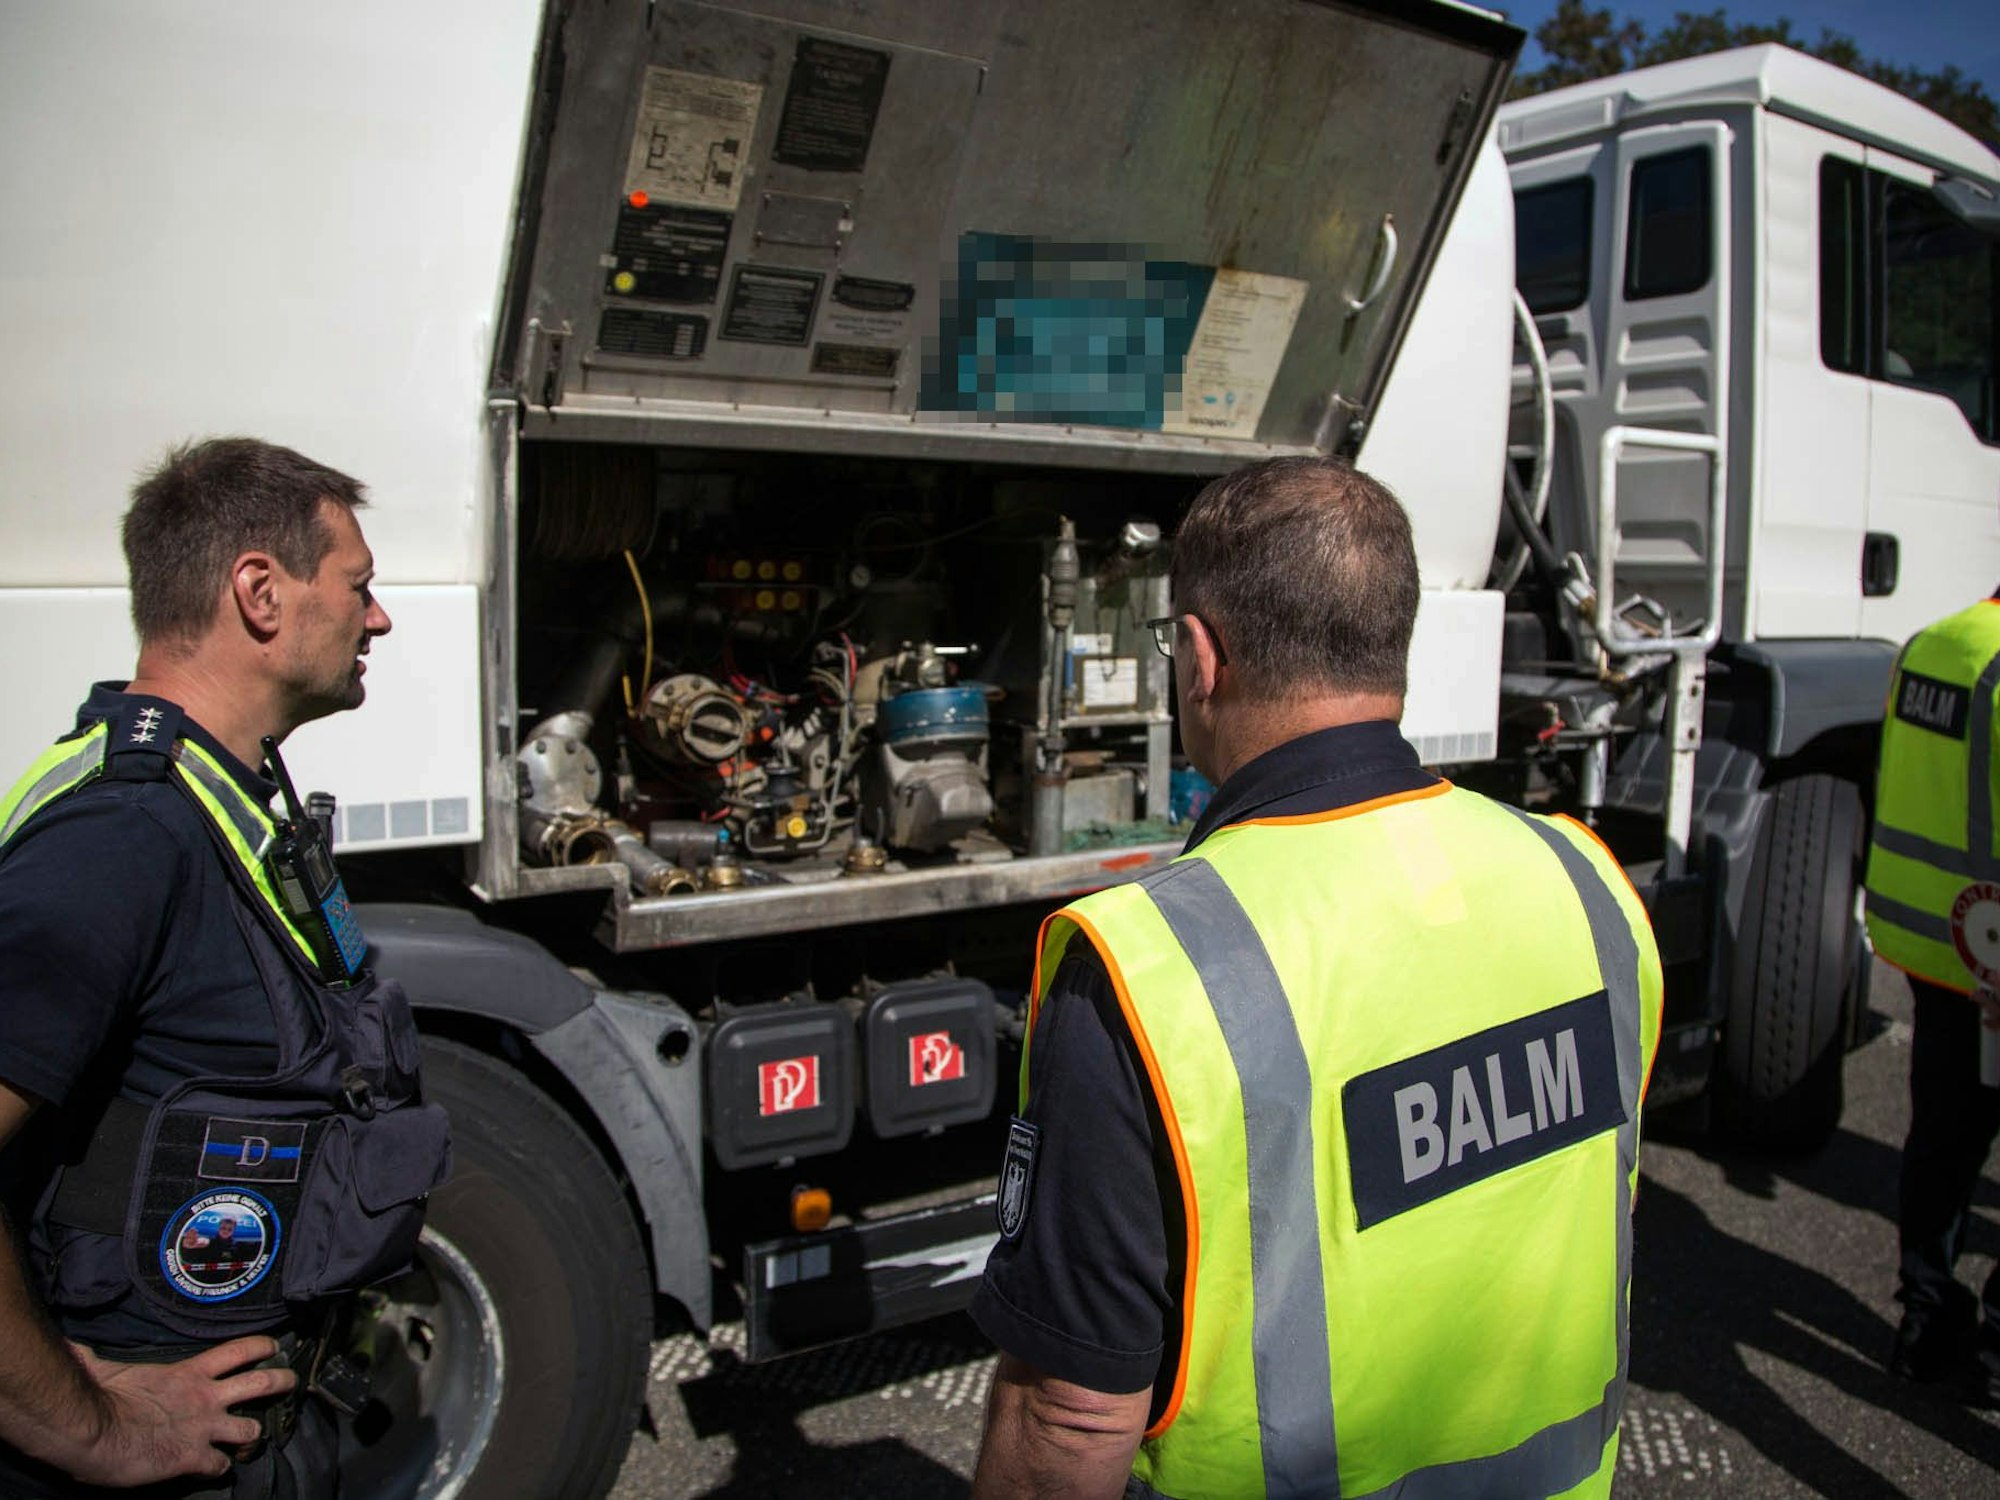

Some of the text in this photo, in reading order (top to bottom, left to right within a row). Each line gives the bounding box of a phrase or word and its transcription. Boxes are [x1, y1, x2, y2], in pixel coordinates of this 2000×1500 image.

[1902, 680, 1957, 728] BALM
[1393, 1028, 1585, 1184] BALM
[236, 1135, 270, 1166] D
[190, 1196, 214, 1214] BITTE
[215, 1193, 241, 1203] KEINE
